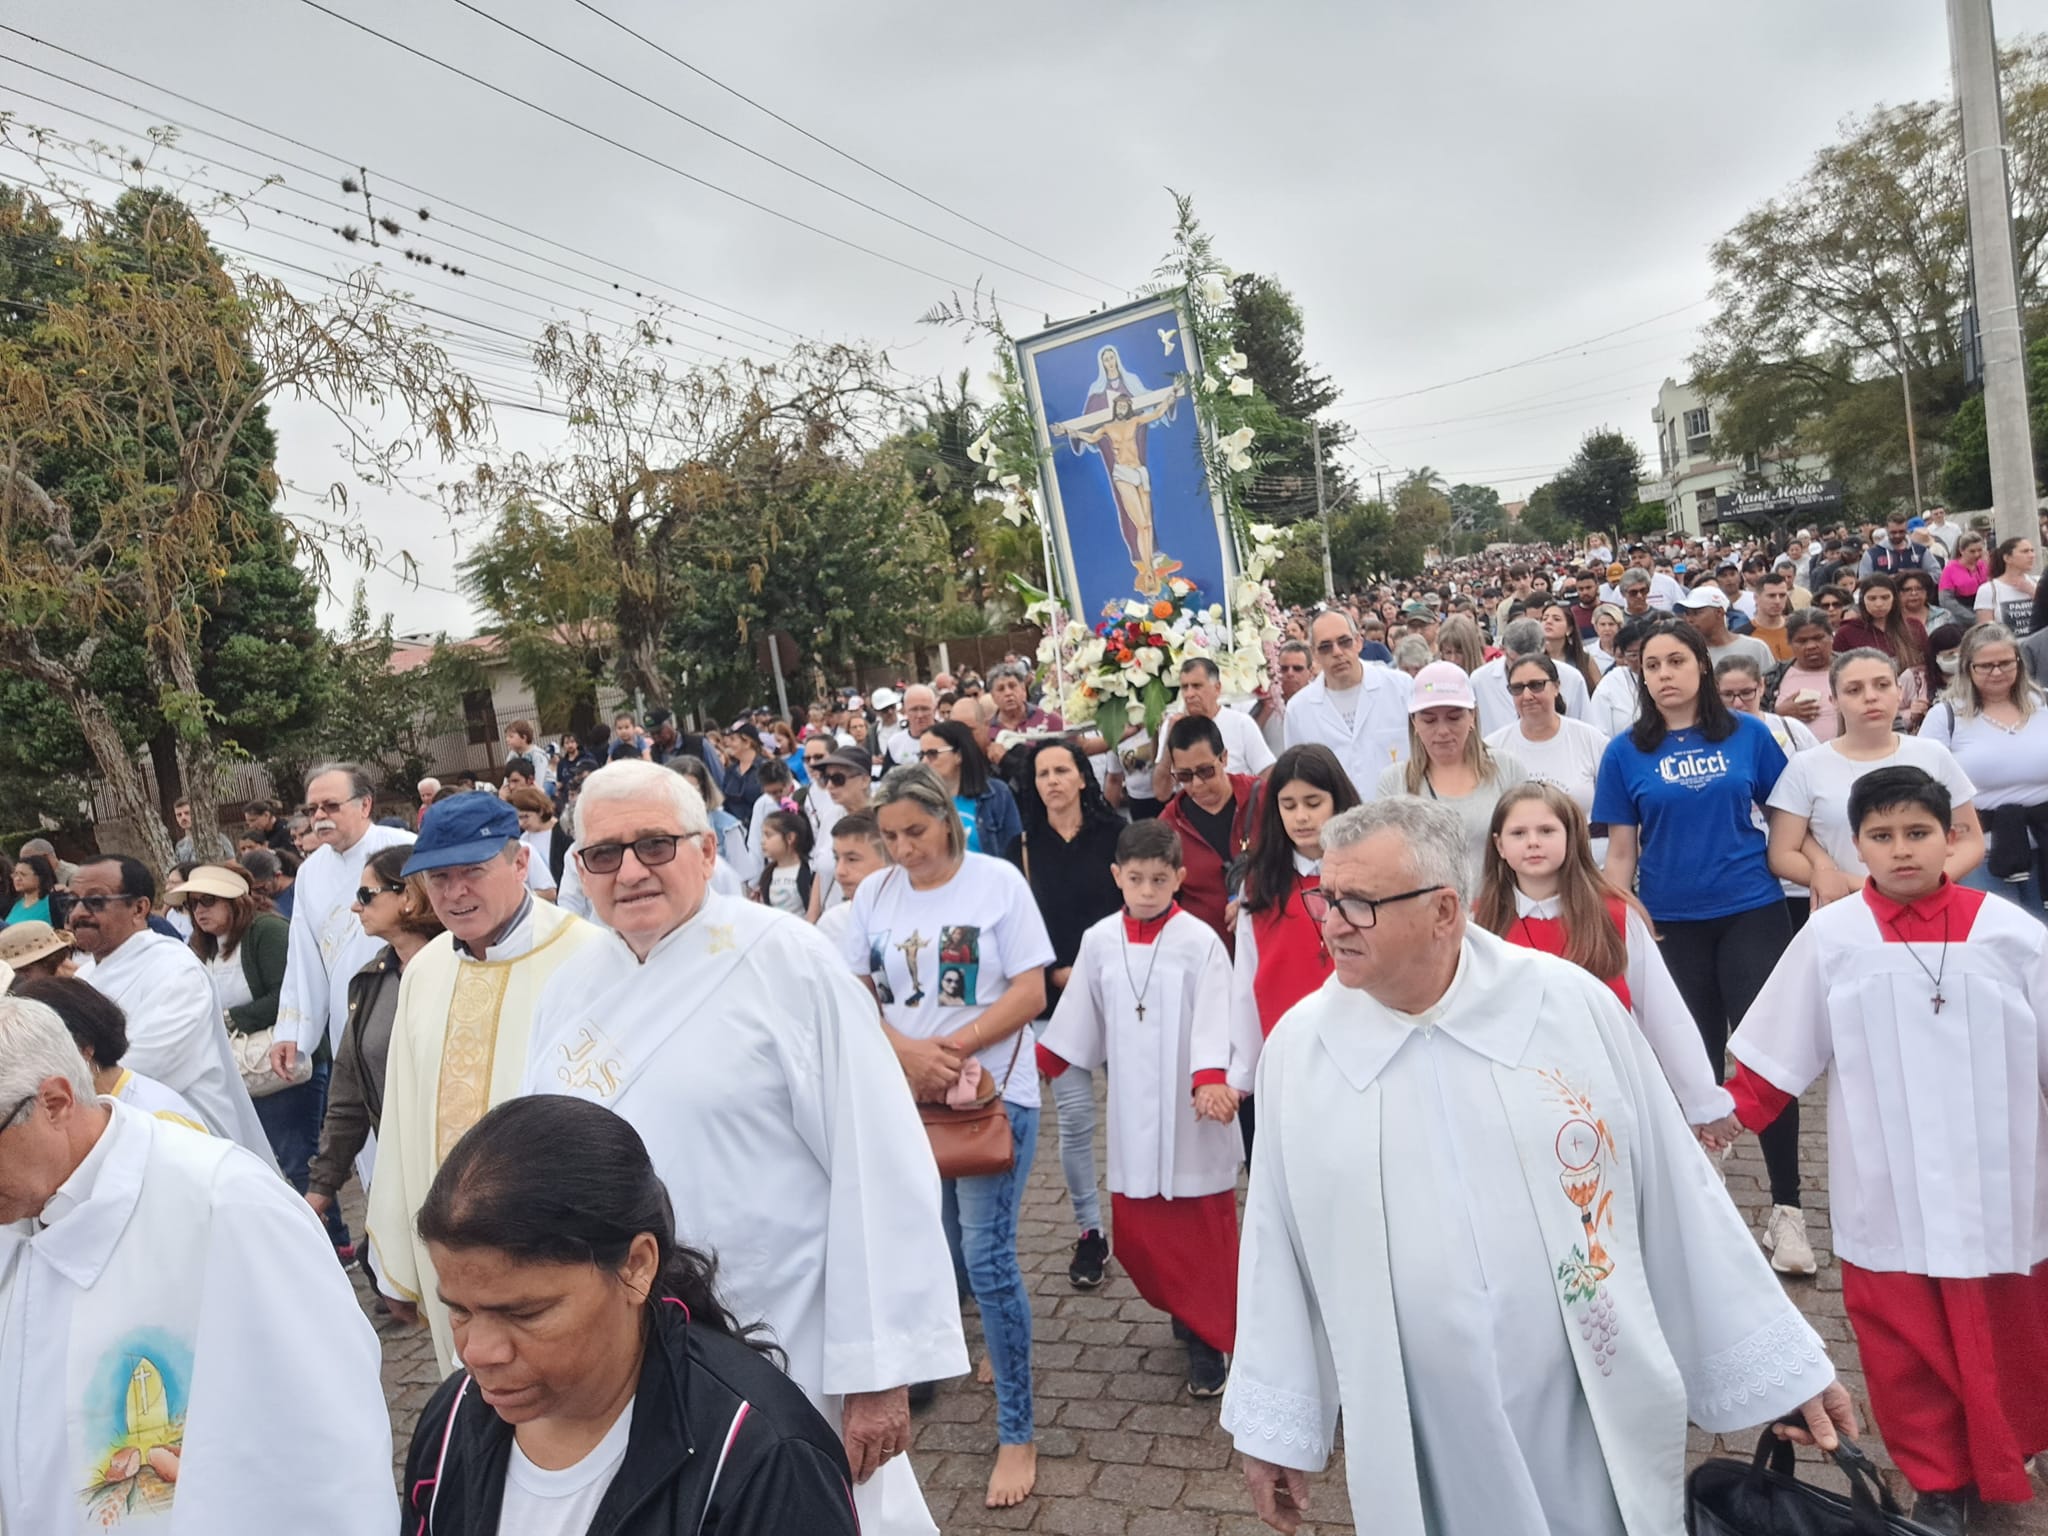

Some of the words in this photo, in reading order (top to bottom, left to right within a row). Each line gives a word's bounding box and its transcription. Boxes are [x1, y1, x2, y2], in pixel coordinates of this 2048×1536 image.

[1772, 483, 1824, 499] Modas
[2009, 610, 2032, 619] TOKY
[1660, 750, 1728, 781] Colcci
